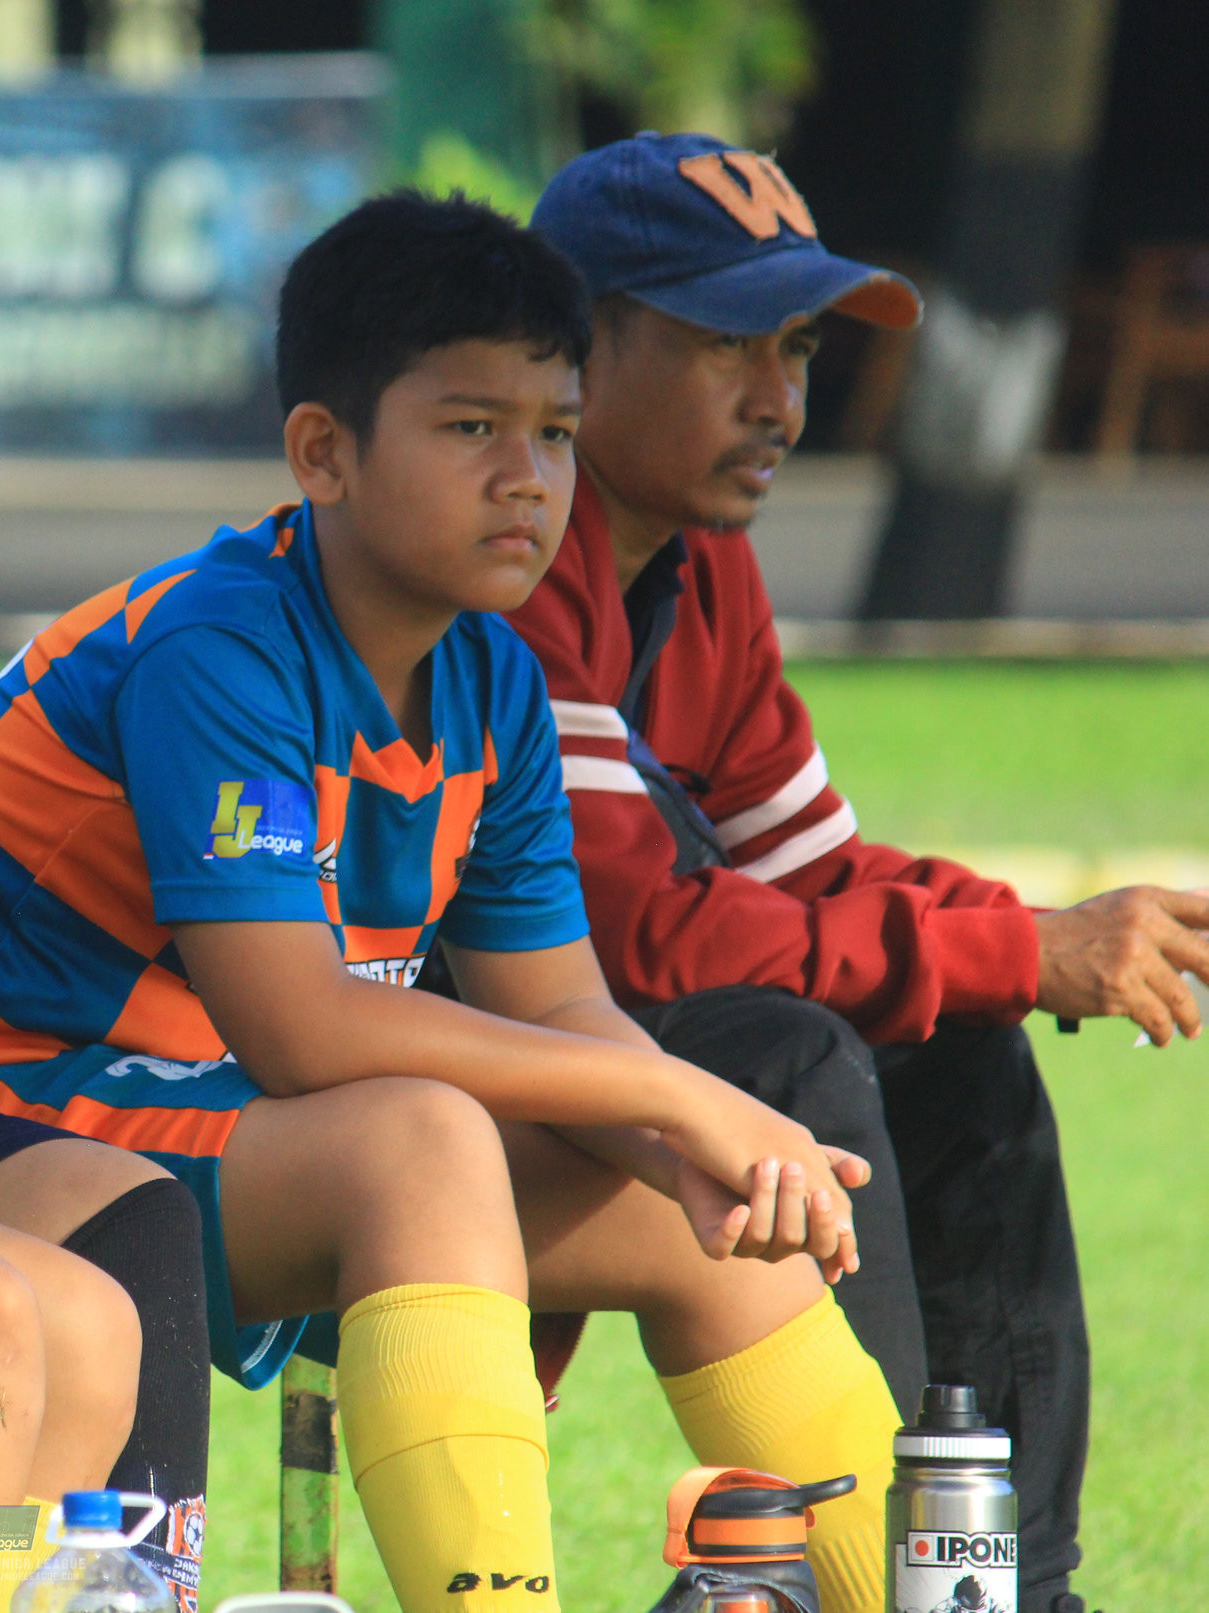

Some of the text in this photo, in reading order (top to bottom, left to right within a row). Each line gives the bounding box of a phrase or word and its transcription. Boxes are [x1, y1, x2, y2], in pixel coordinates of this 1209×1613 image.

[678, 152, 817, 240] W
[238, 829, 303, 856] League
[446, 1573, 550, 1594] avo
